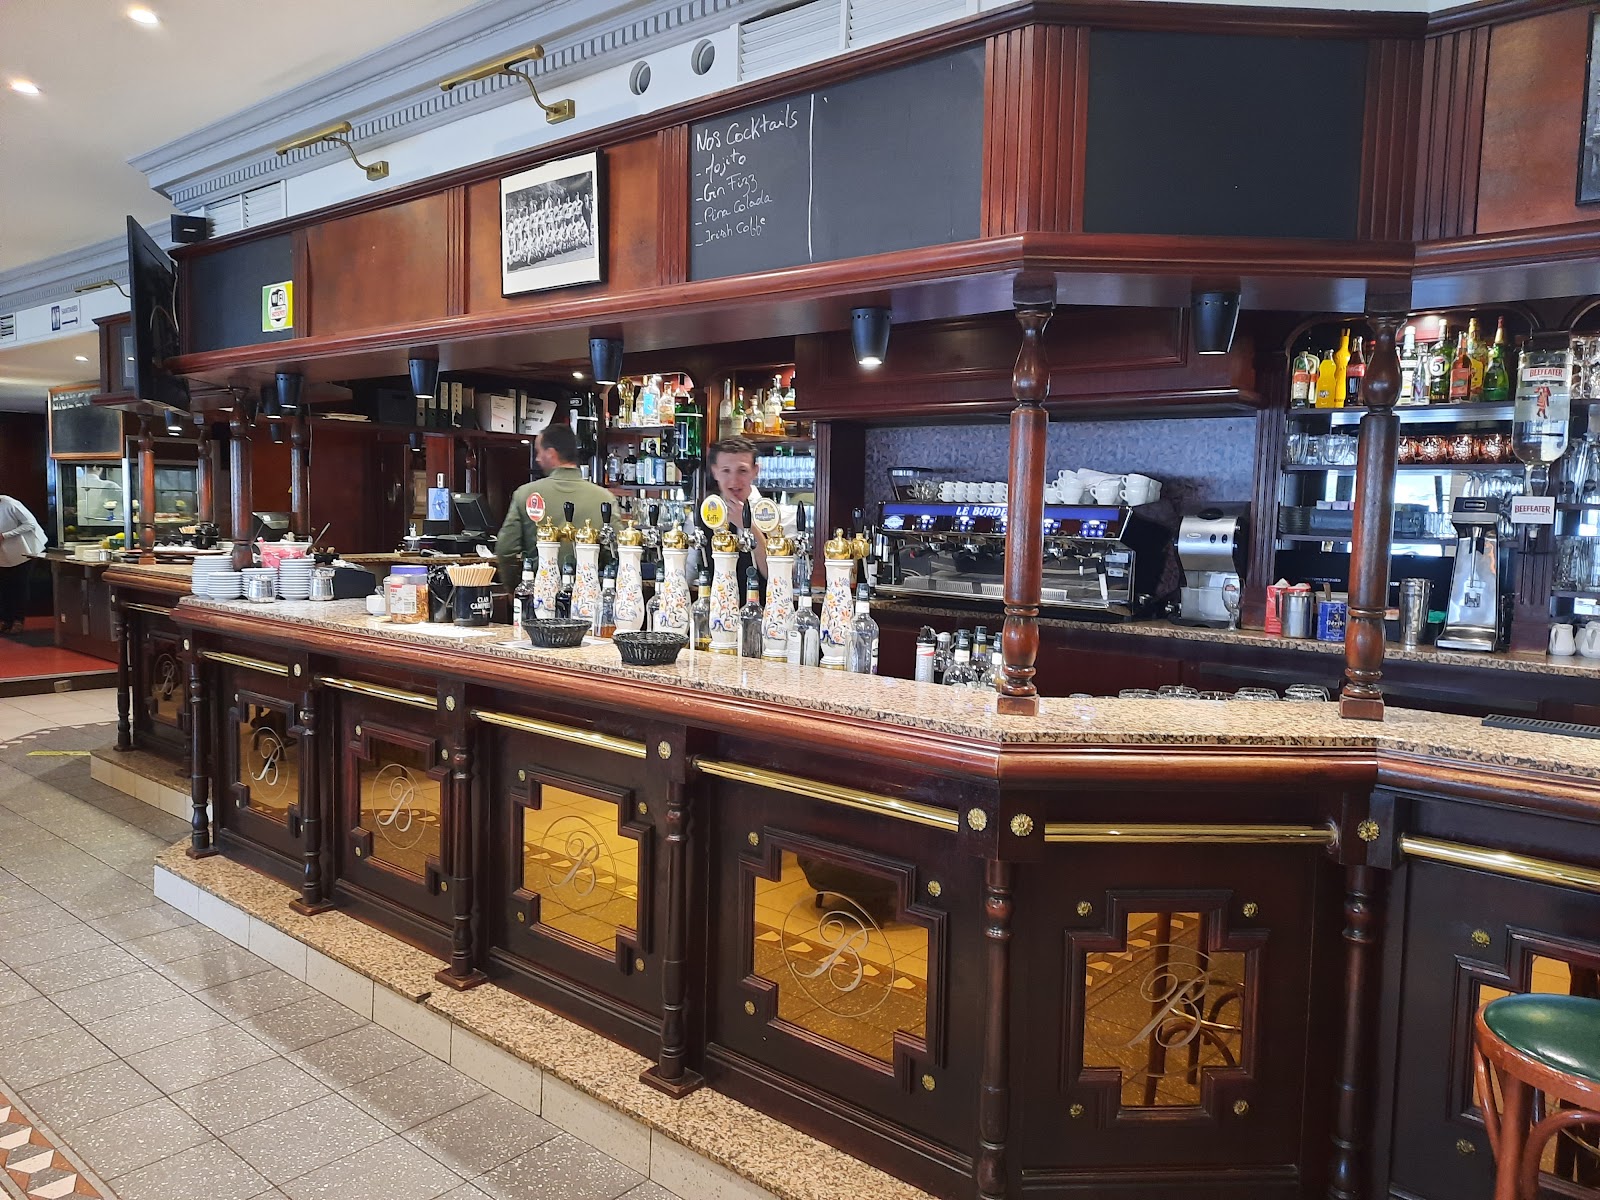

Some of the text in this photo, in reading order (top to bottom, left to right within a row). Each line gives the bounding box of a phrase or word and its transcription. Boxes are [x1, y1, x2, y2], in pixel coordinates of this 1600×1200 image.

[733, 189, 773, 213] Colada
[1432, 360, 1446, 373] 51
[1529, 368, 1563, 378] BEEFEATER
[955, 506, 1008, 517] LE BORDE
[1514, 504, 1551, 514] BEEFEATER
[706, 513, 720, 523] Leffe
